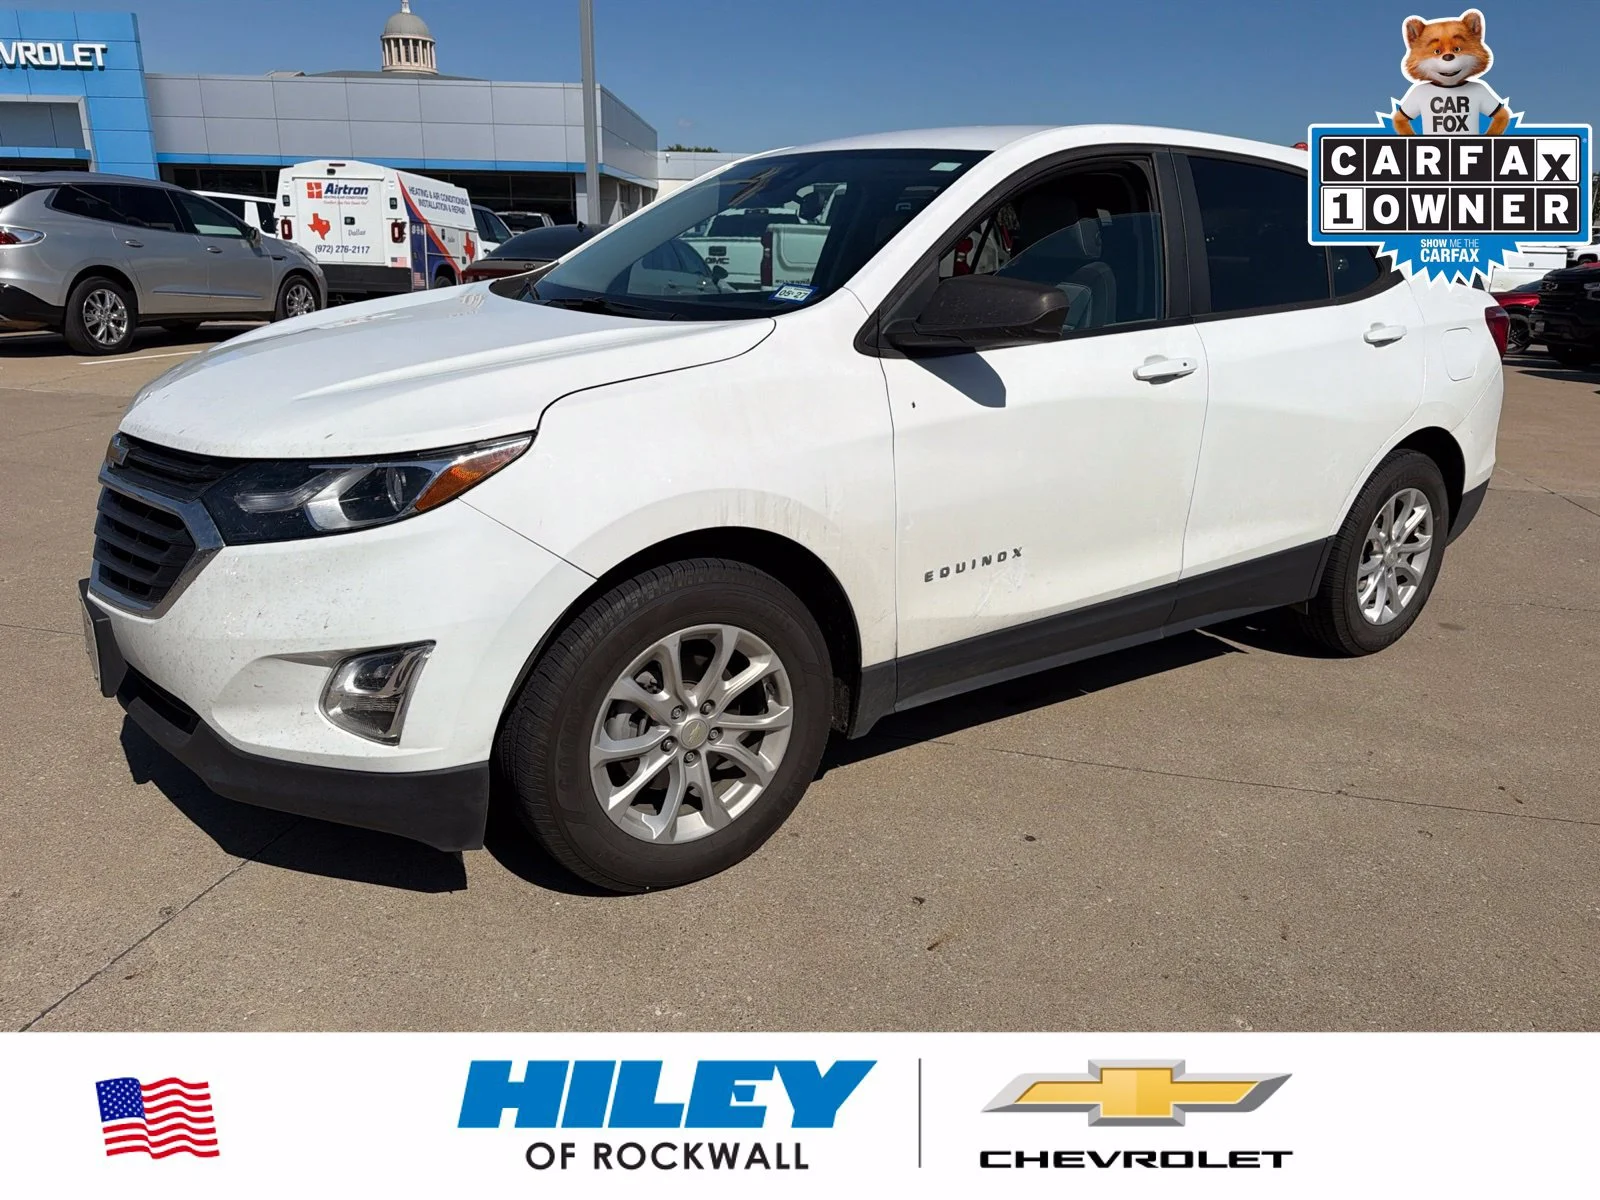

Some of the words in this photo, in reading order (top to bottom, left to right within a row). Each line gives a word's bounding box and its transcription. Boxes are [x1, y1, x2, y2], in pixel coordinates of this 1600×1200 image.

[324, 183, 368, 195] Airtron
[409, 186, 429, 198] HEATING
[440, 193, 469, 206] CONDITIONING
[418, 199, 448, 211] INSTALLATION
[451, 205, 466, 214] REPAIR
[315, 244, 333, 254] (972)
[335, 245, 370, 254] 276-2117
[793, 291, 808, 299] 27
[924, 547, 1022, 583] EQUINOX
